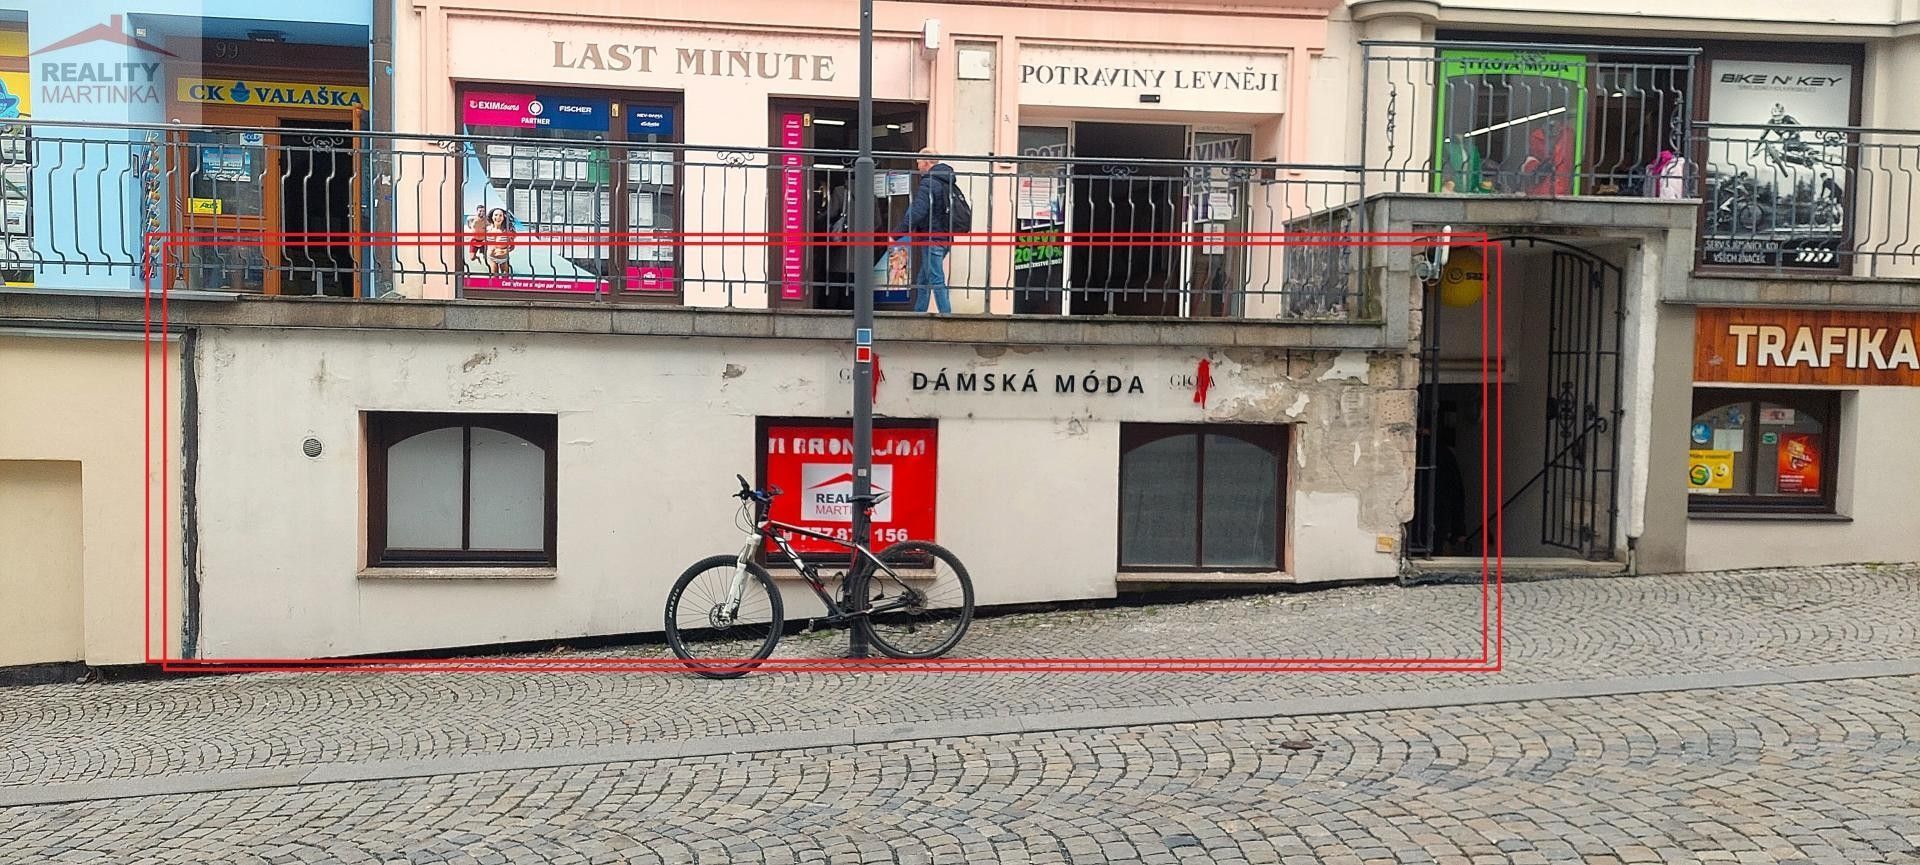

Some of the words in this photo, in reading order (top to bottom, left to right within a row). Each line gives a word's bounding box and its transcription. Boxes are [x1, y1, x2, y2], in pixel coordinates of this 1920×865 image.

[215, 41, 239, 59] 99
[552, 41, 657, 73] LAST
[675, 48, 836, 82] MINUTE
[1021, 64, 1165, 89] POTRAVINY
[1174, 66, 1279, 92] LEVNĚJI
[1720, 73, 1768, 84] BIKE
[1797, 76, 1842, 87] KEY
[189, 84, 225, 101] CK
[255, 86, 362, 107] VALAŠKA
[479, 101, 520, 111] EXIMtours
[559, 105, 593, 113] FISCHER
[521, 117, 550, 125] PARTNER
[1728, 325, 1920, 370] TRAFIKA
[912, 368, 1038, 393] DÁMSKÁ
[1055, 370, 1145, 394] MÓDA
[874, 528, 908, 542] 156
